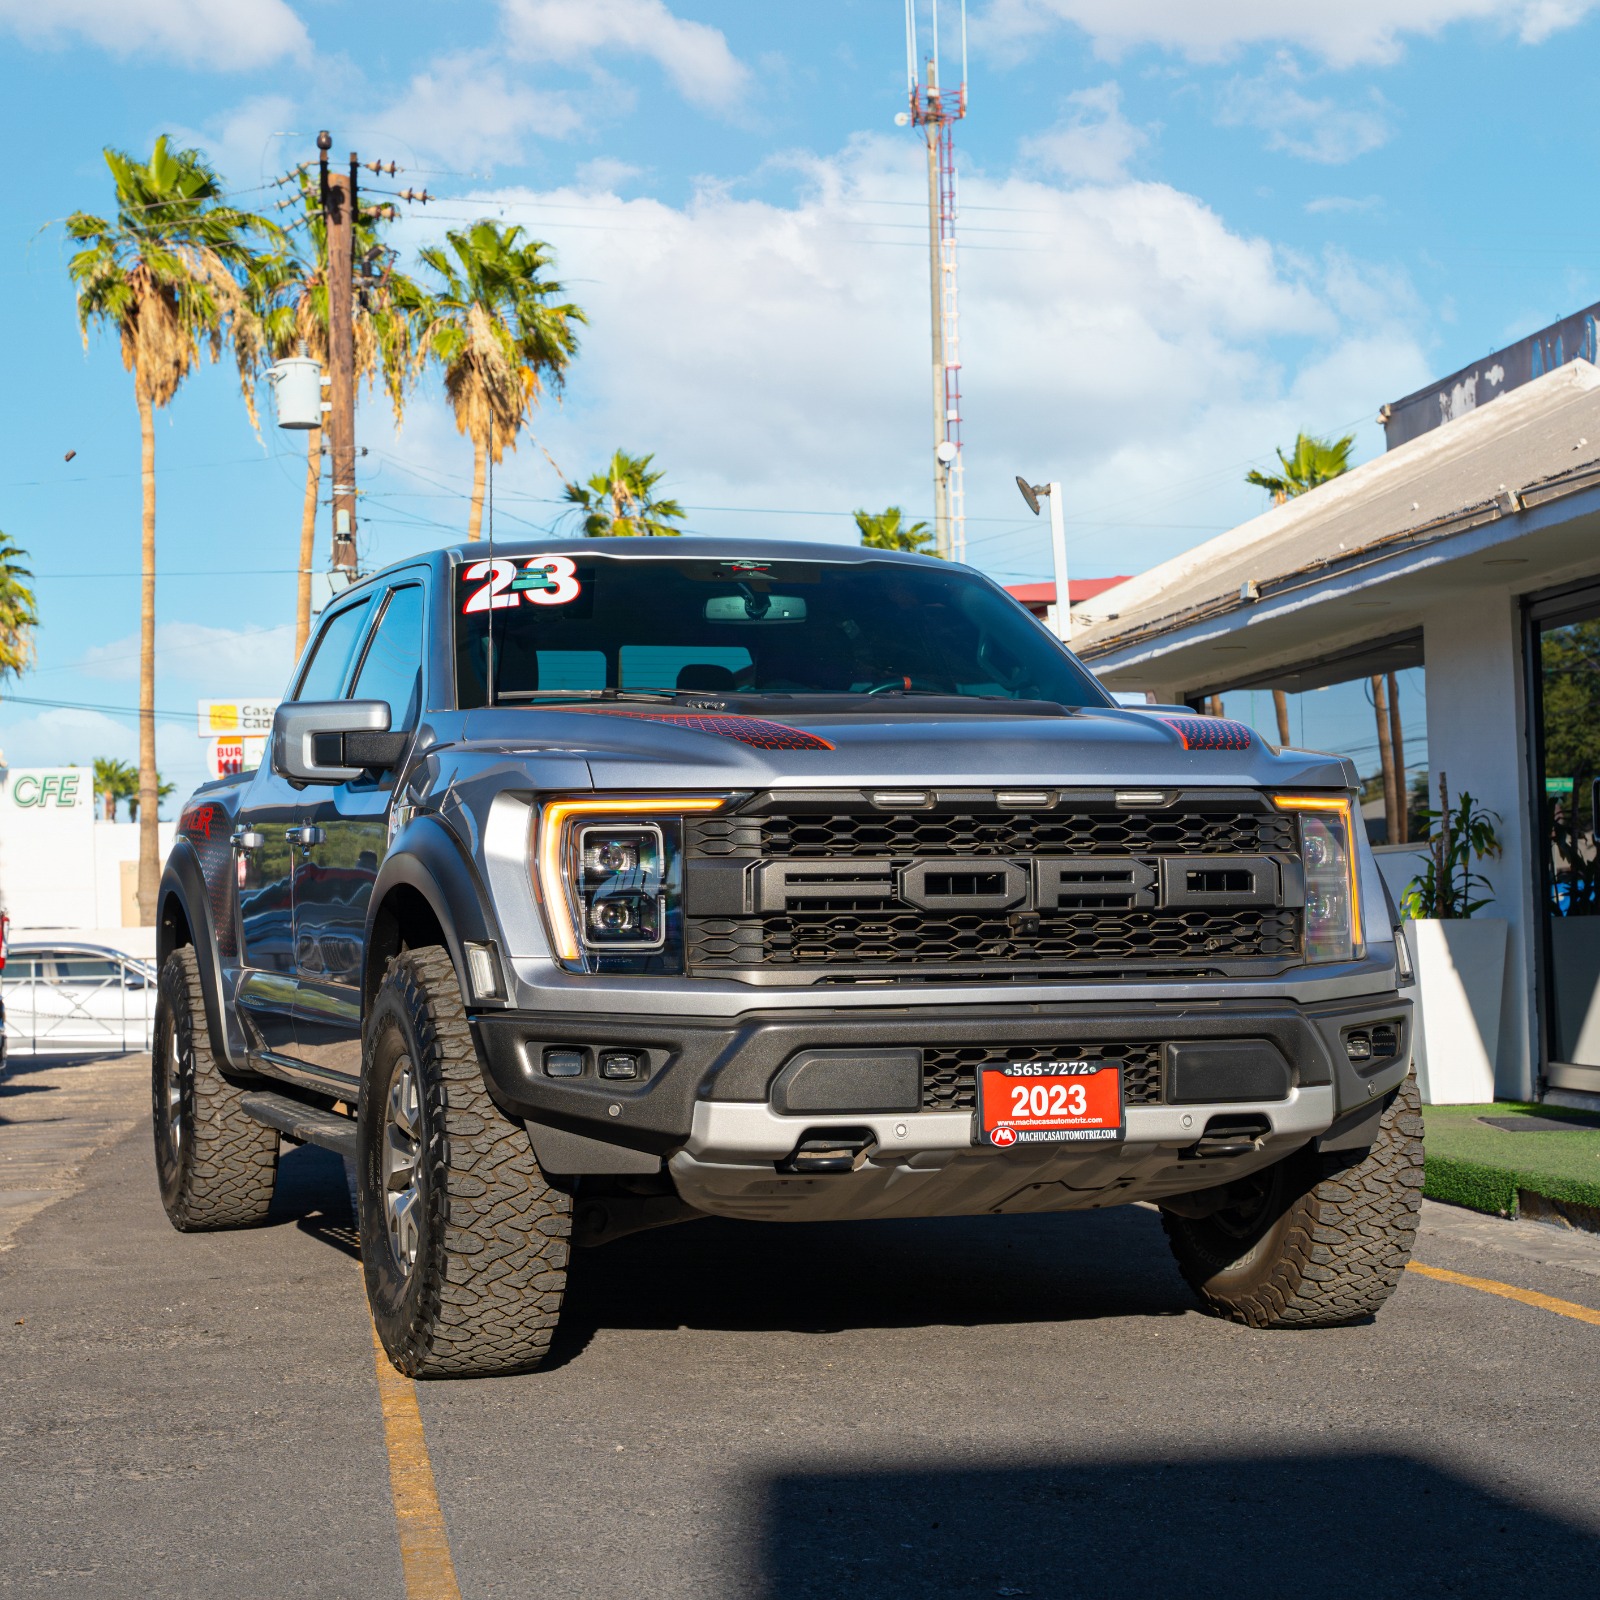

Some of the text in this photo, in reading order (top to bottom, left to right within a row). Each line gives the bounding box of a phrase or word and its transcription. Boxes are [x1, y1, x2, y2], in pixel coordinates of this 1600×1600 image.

[463, 556, 582, 614] 23
[242, 718, 272, 729] Cad
[217, 747, 243, 758] BUR
[217, 759, 243, 774] KI
[13, 775, 80, 807] CFE
[756, 858, 1279, 912] FORD
[1013, 1062, 1088, 1076] 565-7272
[1011, 1084, 1087, 1117] 2023
[997, 1117, 1103, 1126] www.machucasautomotriz.com
[1018, 1129, 1117, 1142] MACHUCASAUTOMOTRIZ.COM
